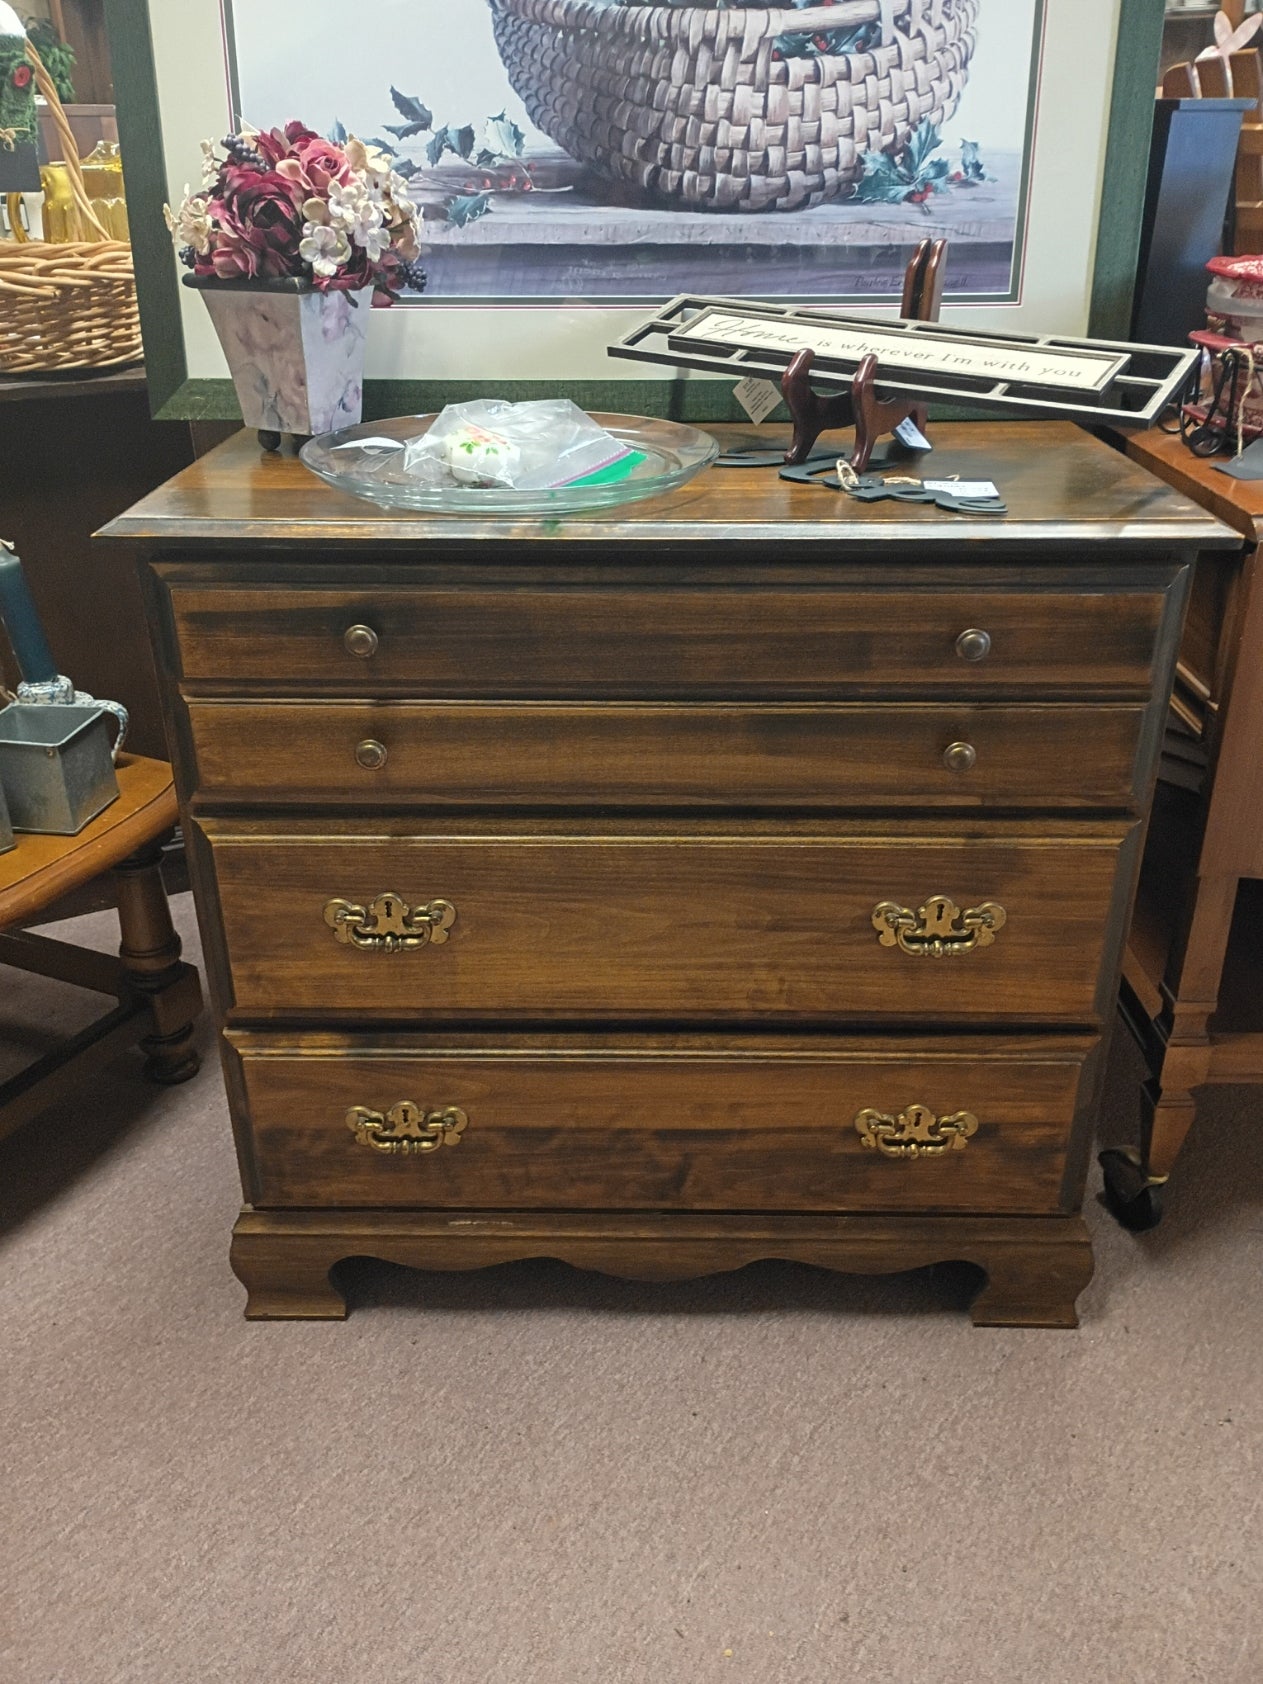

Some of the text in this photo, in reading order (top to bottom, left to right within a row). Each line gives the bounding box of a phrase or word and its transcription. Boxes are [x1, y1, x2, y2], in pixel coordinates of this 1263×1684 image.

[702, 319, 808, 344] Home
[816, 340, 831, 348] is
[841, 340, 934, 360] wherever
[982, 358, 1032, 372] with
[1038, 366, 1082, 378] you
